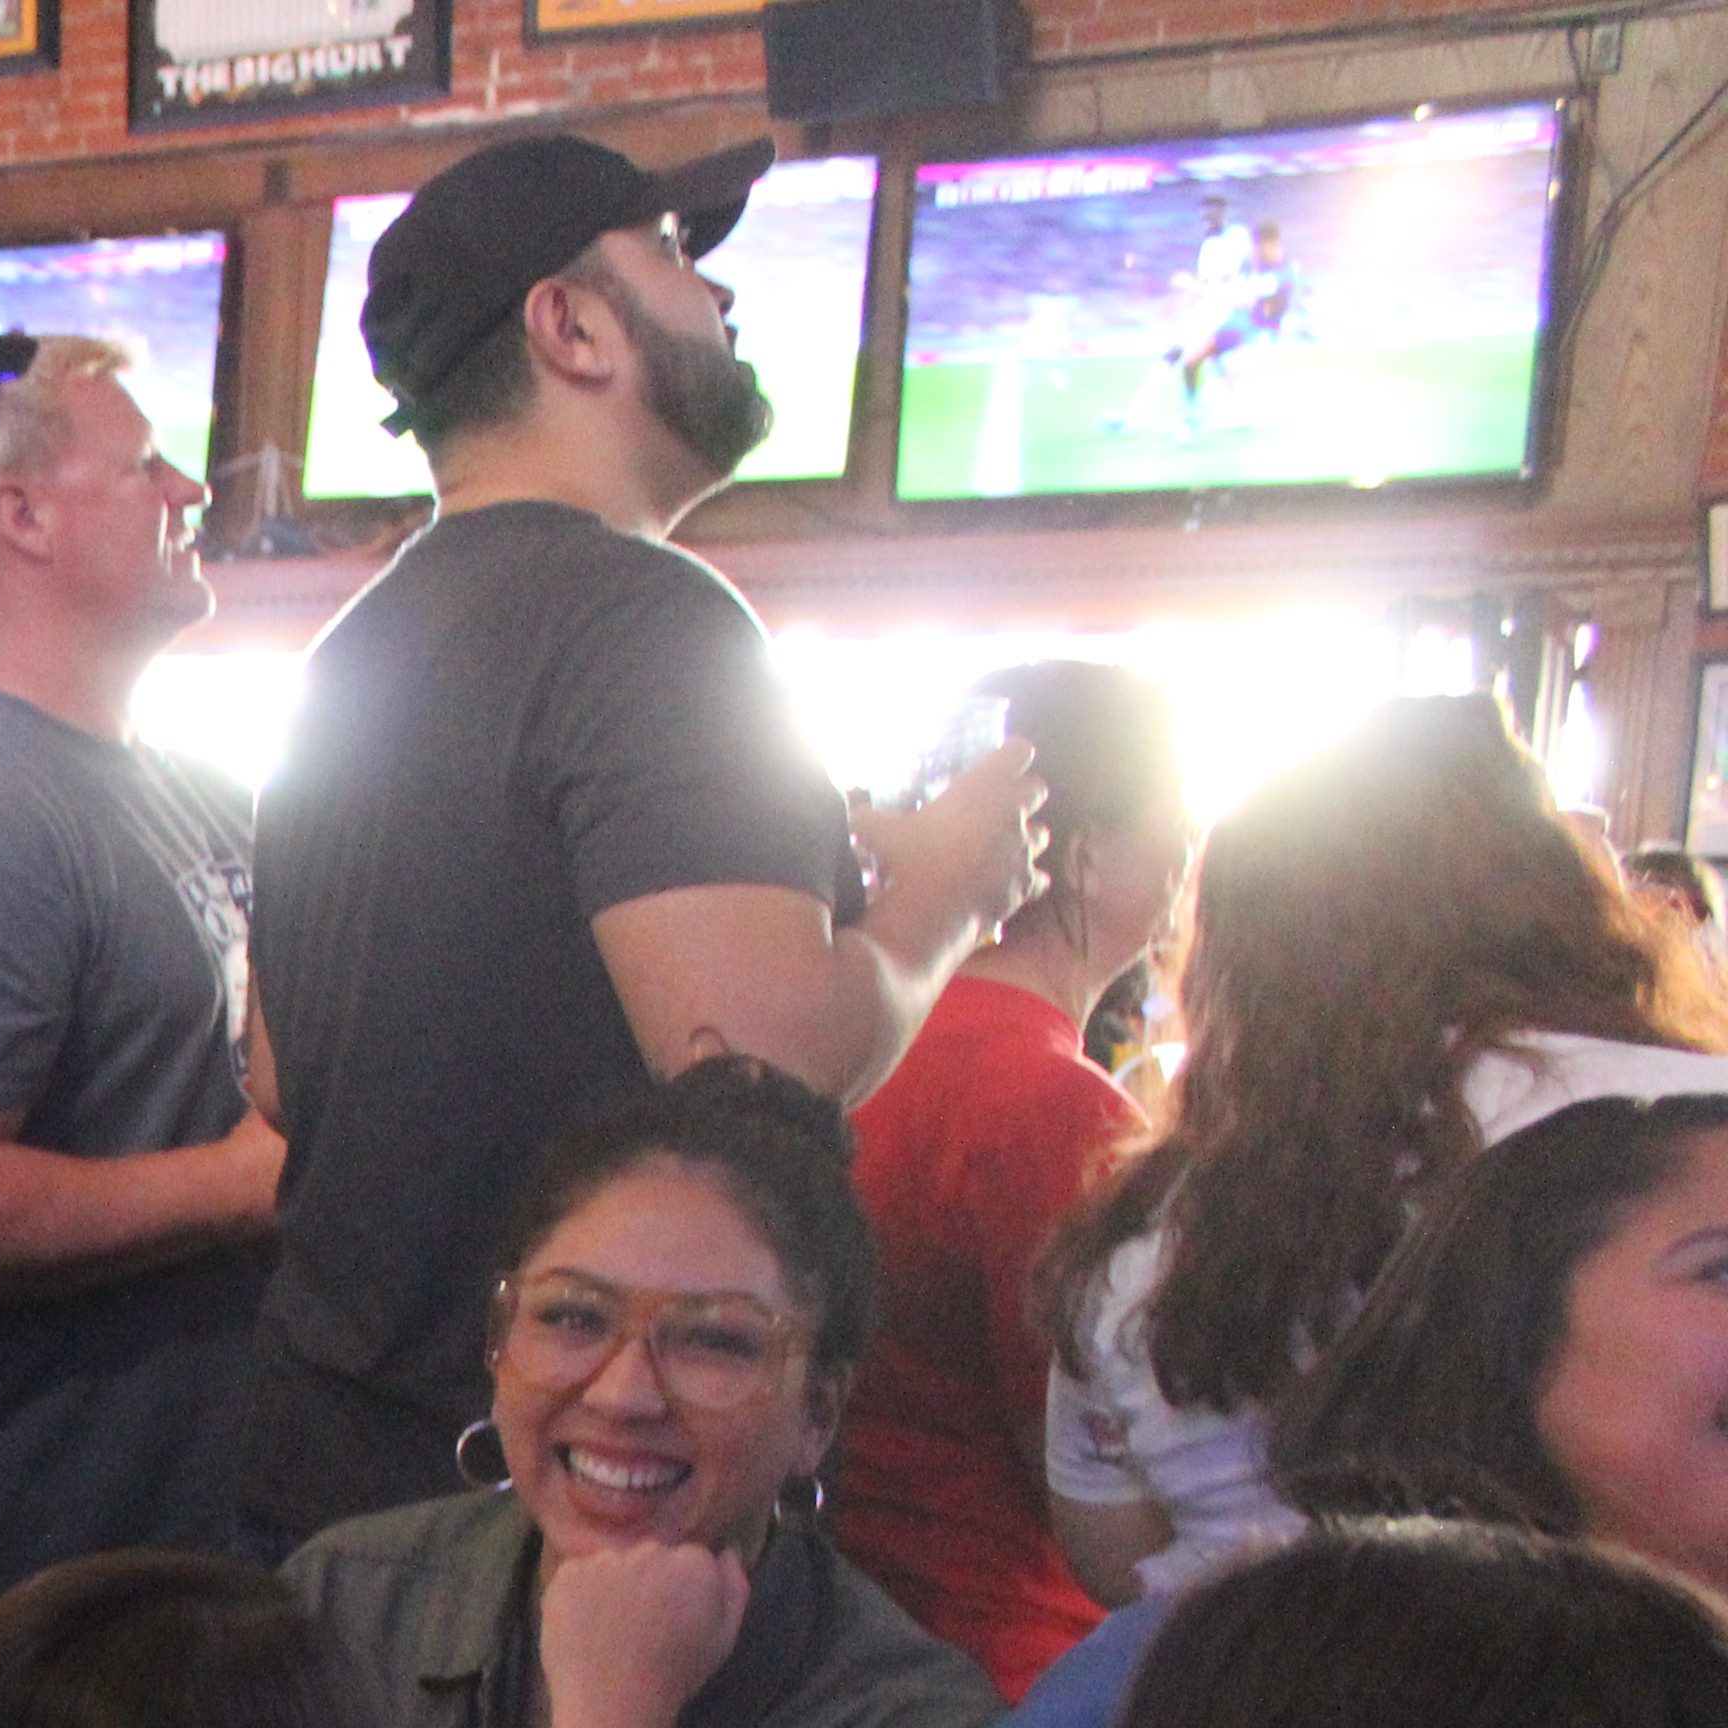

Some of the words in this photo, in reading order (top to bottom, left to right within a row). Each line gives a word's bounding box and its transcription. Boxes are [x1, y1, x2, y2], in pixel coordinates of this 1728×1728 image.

[157, 63, 231, 98] THE
[234, 54, 294, 85] BIG
[296, 35, 413, 80] HURT
